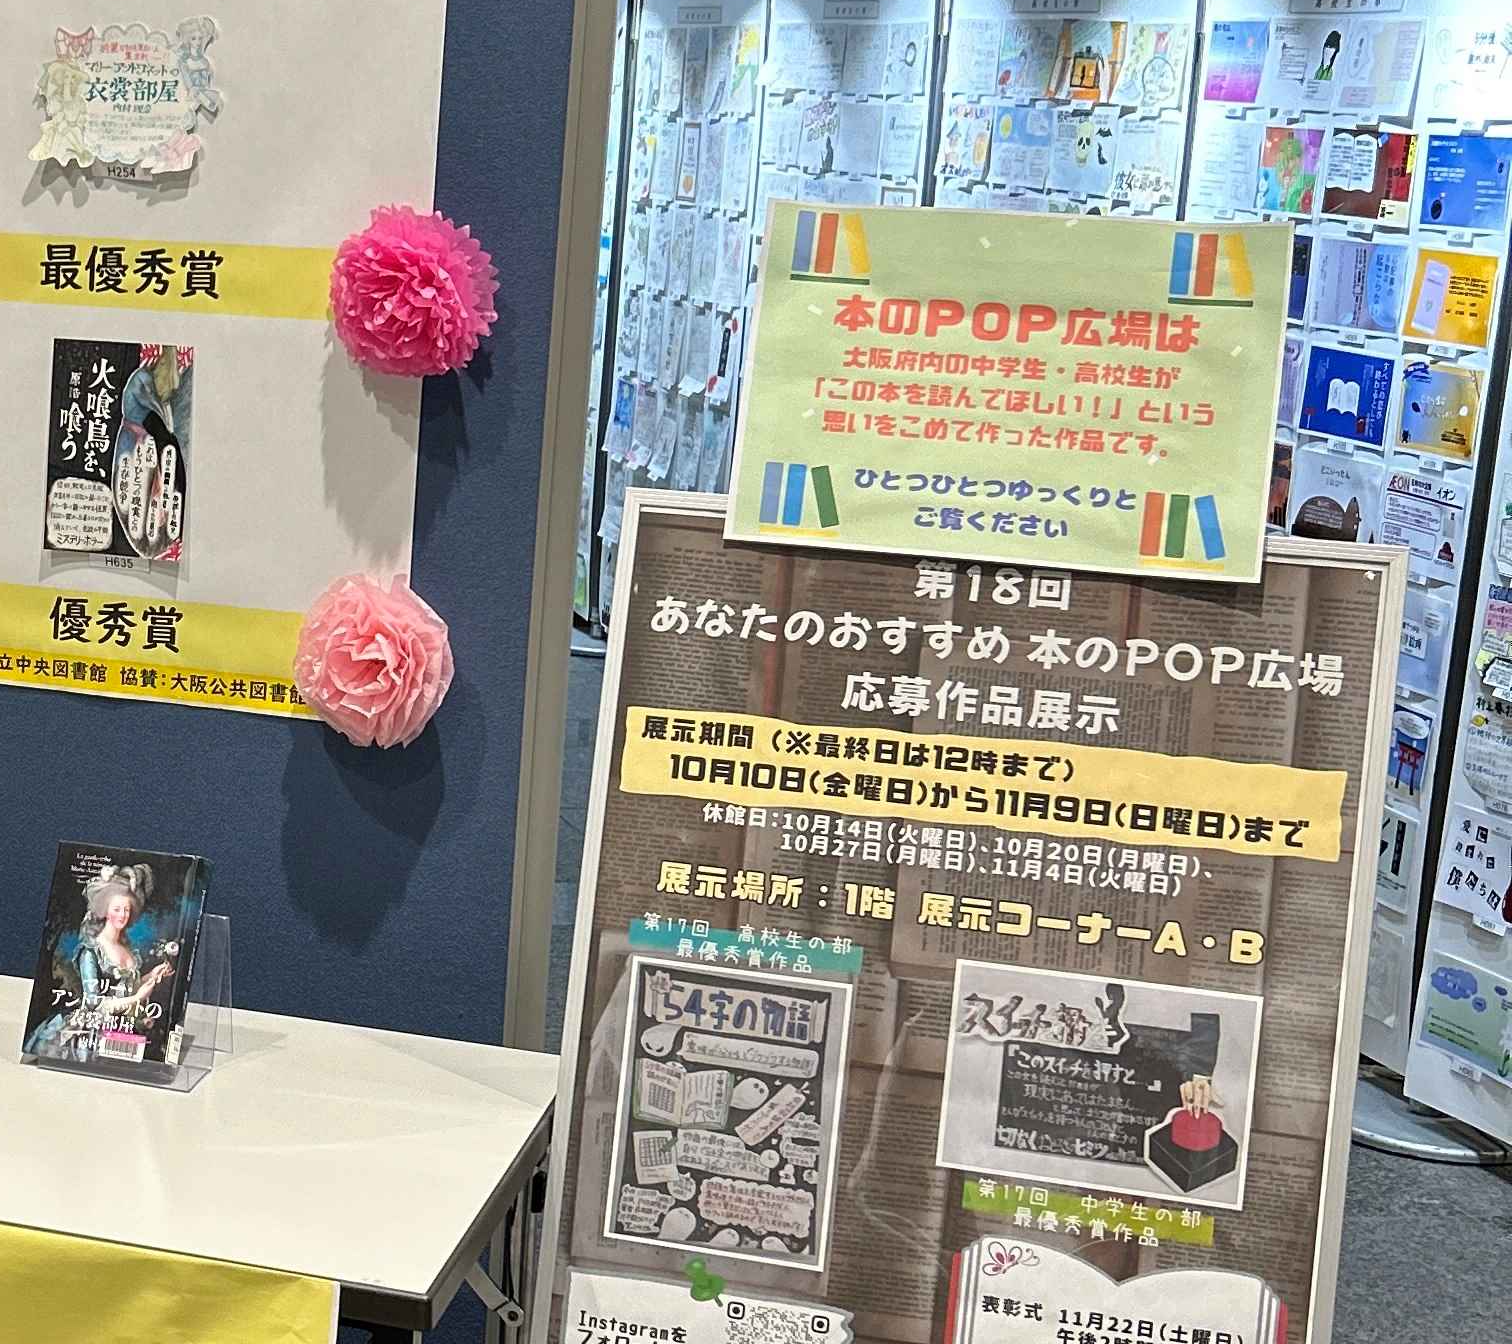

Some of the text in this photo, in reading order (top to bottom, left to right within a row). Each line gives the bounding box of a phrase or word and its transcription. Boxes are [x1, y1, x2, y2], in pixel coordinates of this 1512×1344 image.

[107, 167, 136, 178] H254
[39, 243, 224, 299] 最優秀賞
[832, 293, 1202, 353] 本のPOP広場は
[842, 346, 1182, 391] 大阪府内の中学生・高校生が
[814, 377, 1216, 427] 「この本を読んでほしい！」という
[59, 401, 86, 461] 喰う
[822, 409, 1170, 458] 思いをこめて作った作品です。
[854, 467, 1137, 511] ひとつひとつゆっくりと
[912, 506, 1069, 537] ご覧ください
[105, 556, 134, 569] H635
[912, 559, 1072, 611] 第18回
[48, 595, 185, 655] 優秀賞
[648, 593, 1346, 696] あなたのおすすめ 本のPOP広場
[840, 670, 1121, 736] 応募作品展示
[669, 751, 1313, 848] 10月10日（金曜日）から11月9日（日曜日）まで
[701, 801, 1214, 879] 休館日：10月14日（火曜日）、10月20日（月曜日）、
[779, 832, 1184, 898] 10月27日（月曜日）、11月4日（火曜日）
[643, 912, 854, 956] 第17回 高校生の部
[656, 860, 1265, 967] 展示場所：1階 展示コーナーA・B
[675, 940, 813, 974] 最優秀賞作品
[661, 981, 811, 1042] 54字の物語
[977, 1178, 1202, 1229] 第17回 中学生の部
[1013, 1206, 1160, 1248] 最優秀賞作品
[579, 1309, 688, 1344] Instagramを
[982, 1294, 1043, 1323] 表彰式
